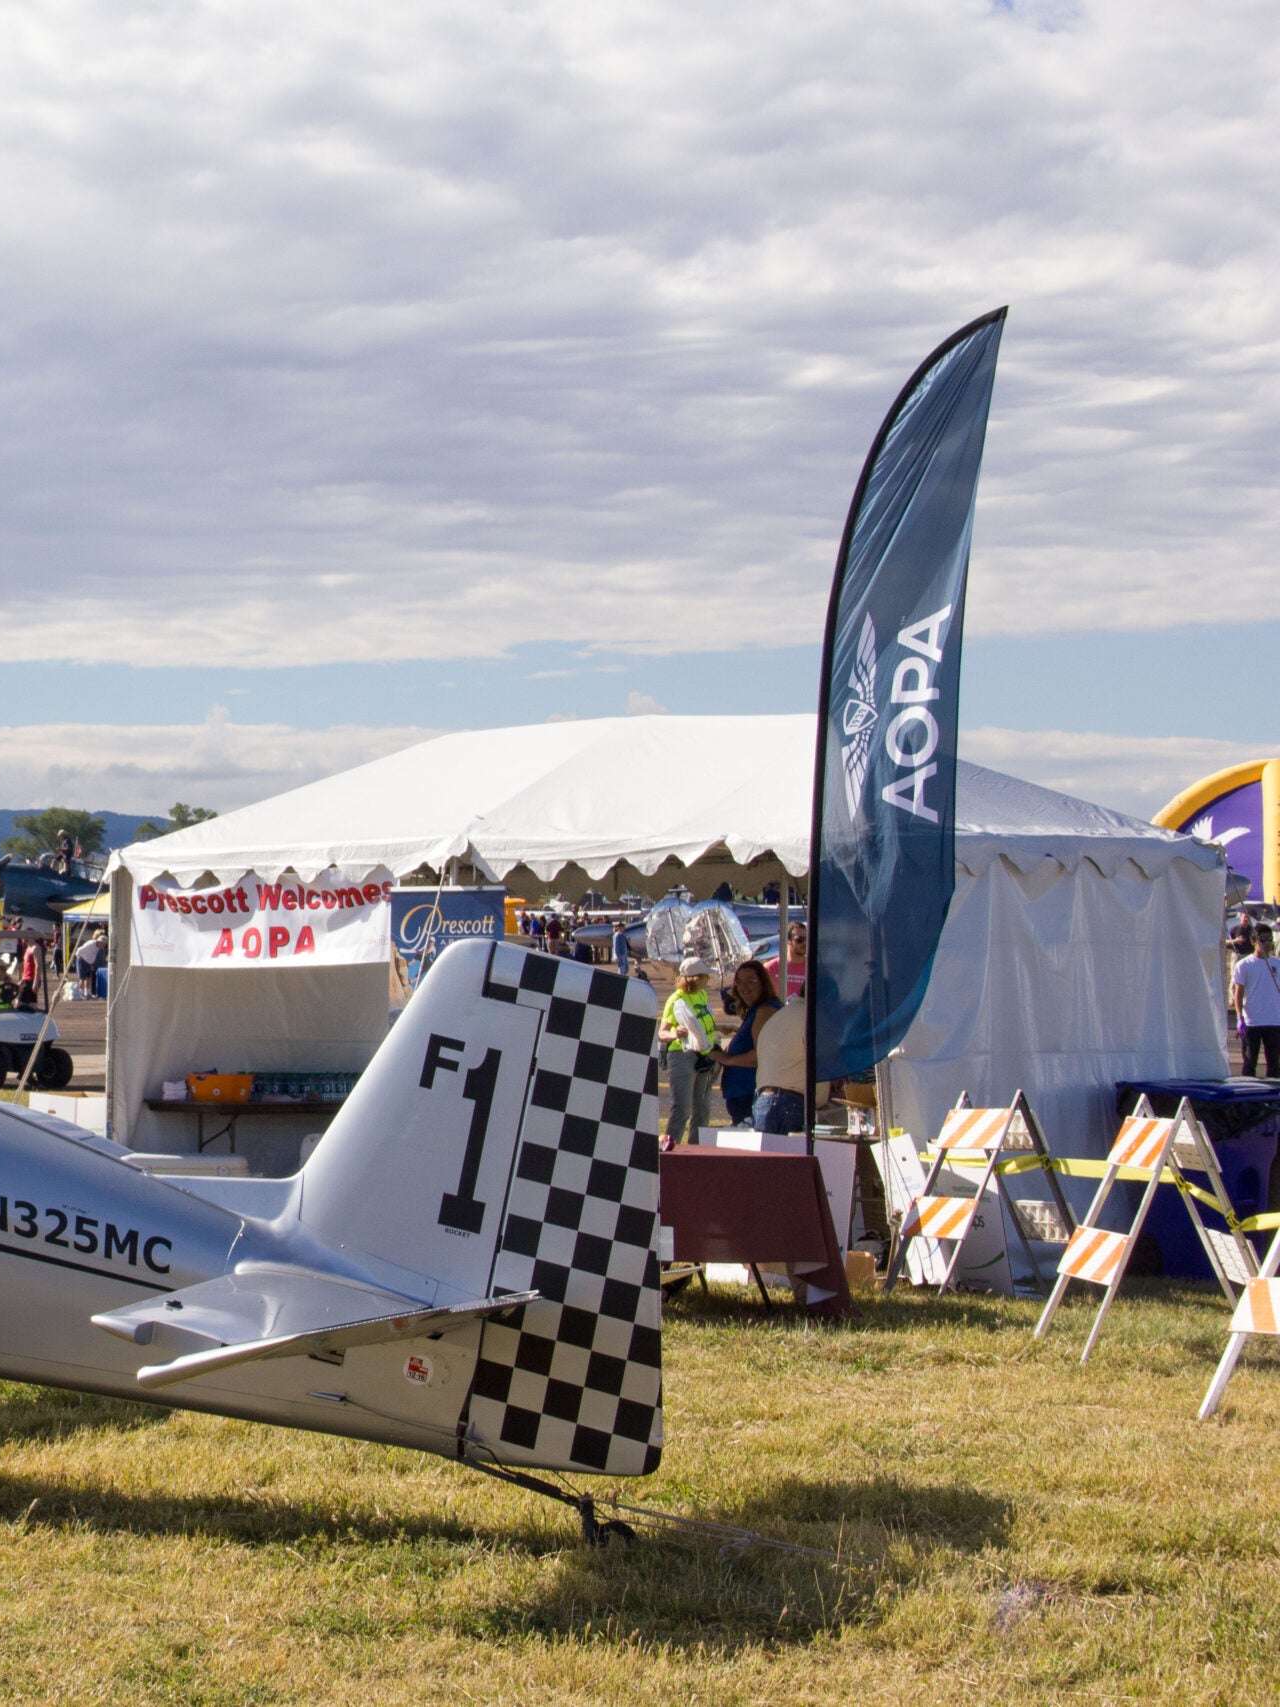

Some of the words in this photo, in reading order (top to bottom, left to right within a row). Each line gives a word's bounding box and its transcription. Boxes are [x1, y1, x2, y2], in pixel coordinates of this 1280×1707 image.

[882, 603, 951, 824] AOPA
[140, 884, 250, 915] Prescott
[256, 880, 394, 911] Welcomes
[211, 925, 316, 959] AOPA
[400, 903, 495, 953] Prescott
